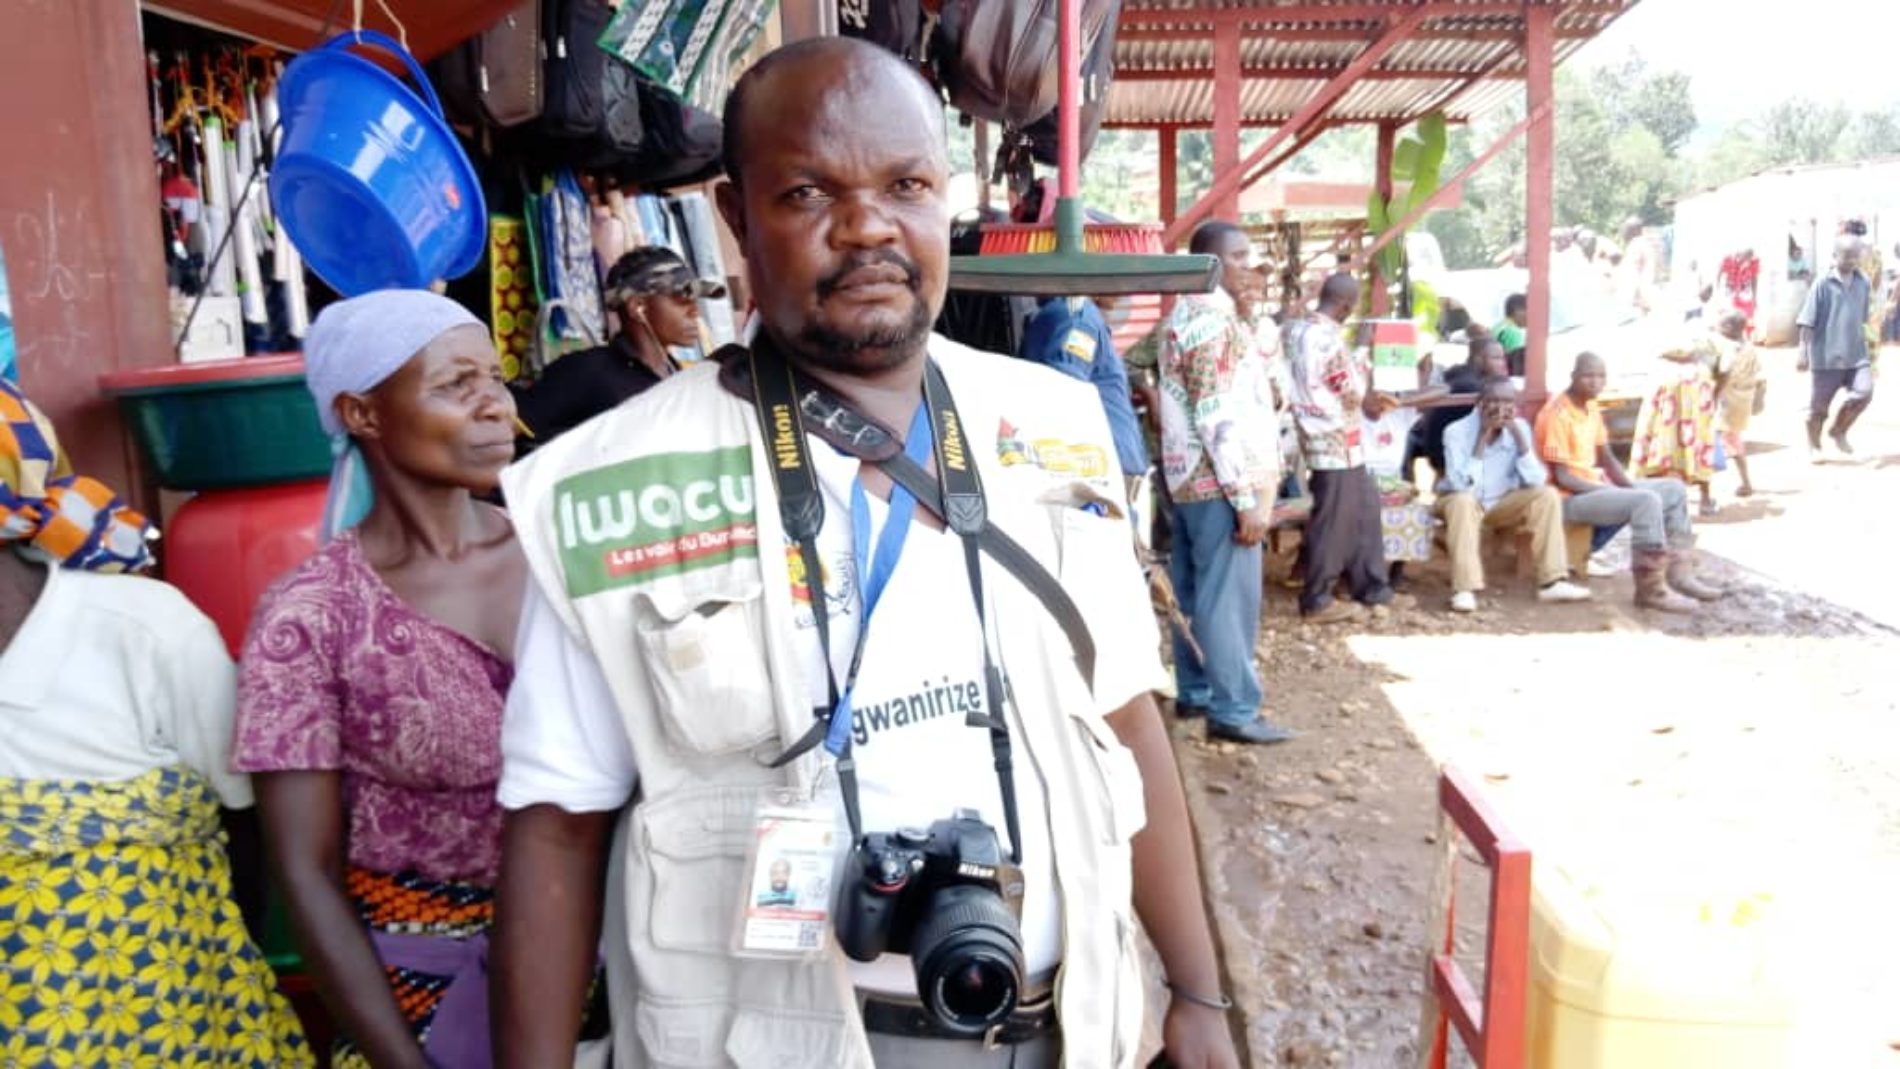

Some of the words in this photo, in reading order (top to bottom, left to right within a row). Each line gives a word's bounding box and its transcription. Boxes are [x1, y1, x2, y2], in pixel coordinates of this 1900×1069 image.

[772, 404, 801, 470] Nikon
[943, 410, 966, 471] Nikon
[560, 474, 755, 549] Iwacu
[611, 549, 644, 566] Les
[957, 862, 996, 877] Nikon
